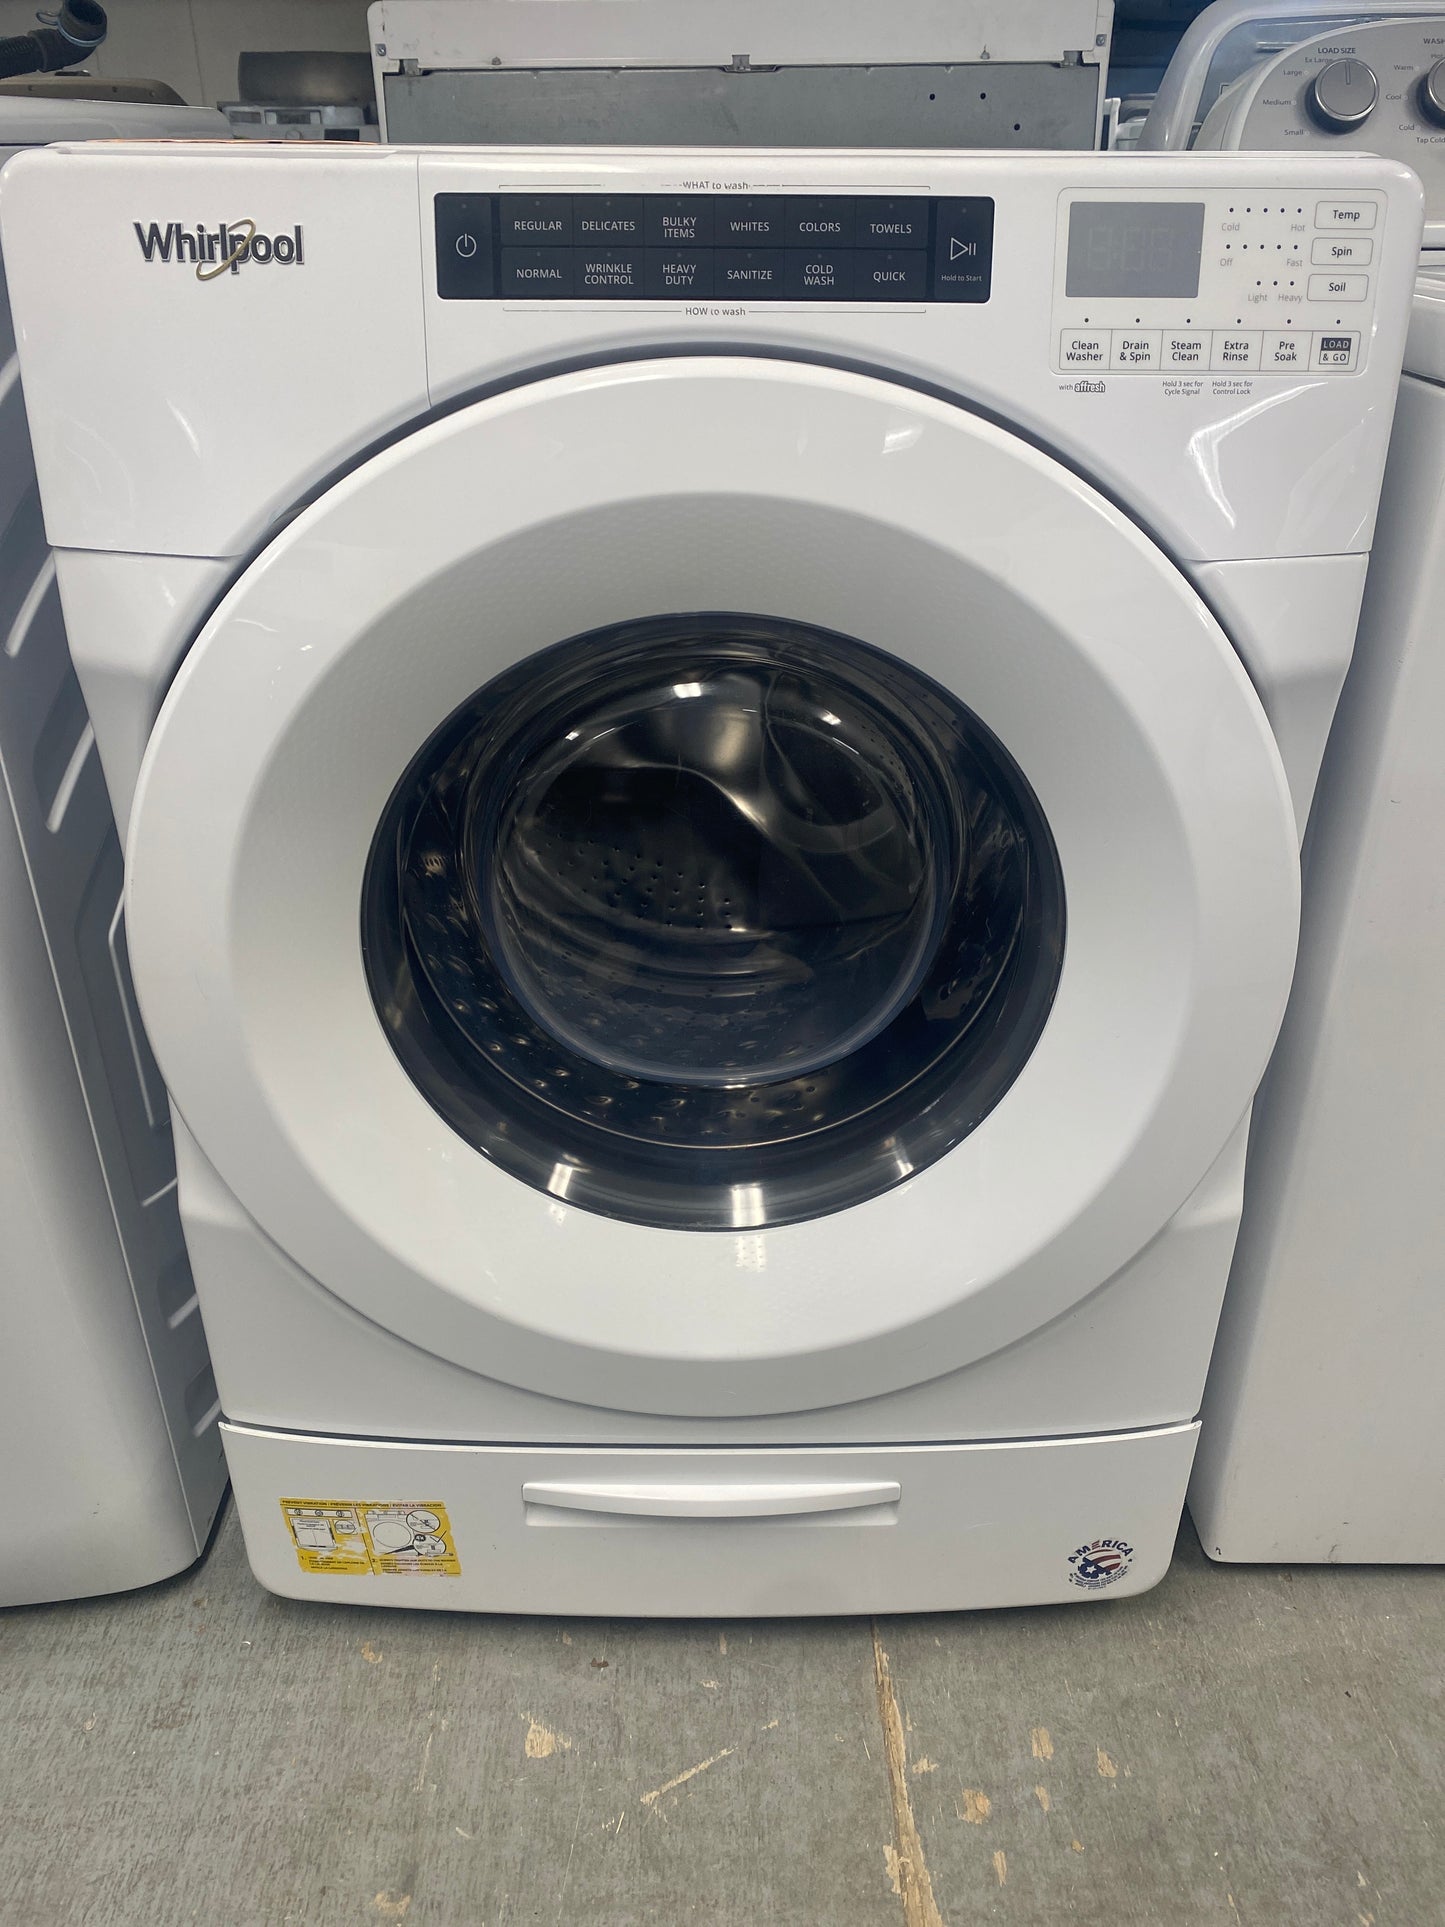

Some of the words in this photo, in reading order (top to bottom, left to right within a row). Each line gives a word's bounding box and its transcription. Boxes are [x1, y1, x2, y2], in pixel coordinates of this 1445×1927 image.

[683, 181, 709, 190] WHAT
[712, 182, 722, 190] to
[725, 181, 749, 190] wash
[1333, 209, 1360, 222] Temp
[514, 220, 562, 231] REGULAR
[581, 221, 636, 232] DELICATES
[662, 216, 697, 227] BULKY
[730, 222, 770, 232] WHITES
[799, 222, 841, 232] COLORS
[870, 223, 912, 234] TOWELS
[1221, 222, 1240, 232] Cold
[1290, 224, 1306, 232] Hot
[664, 228, 696, 238] ITEMS
[133, 222, 305, 274] Whirlpool
[1331, 246, 1352, 258] Spin
[1220, 258, 1233, 267] Off
[1286, 258, 1303, 267] Fast
[516, 268, 562, 278] NORMAL
[585, 264, 632, 274] WRINKLE
[662, 264, 697, 274] HEAVY
[805, 264, 834, 274] COLD
[584, 274, 634, 285] CONTROL
[727, 270, 772, 280] SANITIZE
[873, 271, 906, 282] QUICK
[941, 274, 956, 282] Hold
[665, 276, 694, 286] DUTY
[804, 275, 834, 286] WASH
[1328, 282, 1346, 292] Soil
[1248, 292, 1268, 304] Light
[1278, 293, 1303, 304] Heavy
[686, 307, 708, 316] HOW
[710, 308, 720, 316] to
[722, 308, 746, 316] wash
[1071, 340, 1099, 350] Clean
[1122, 340, 1150, 350] Drain
[1171, 340, 1202, 350] Steam
[1224, 340, 1250, 350] Extra
[1278, 340, 1295, 350] Pre
[1323, 340, 1350, 349] LOAD
[1066, 351, 1104, 362] Washer
[1120, 352, 1127, 362] &
[1128, 351, 1151, 364] Spin
[1172, 352, 1199, 362] Clean
[1222, 352, 1249, 362] Rinse
[1274, 352, 1298, 362] Soak
[1322, 353, 1328, 362] &
[1332, 353, 1346, 362] GO
[1074, 381, 1106, 393] affresh
[1164, 388, 1180, 396] Cycle
[1182, 388, 1200, 396] Signal
[1068, 1540, 1133, 1563] AMERICA
